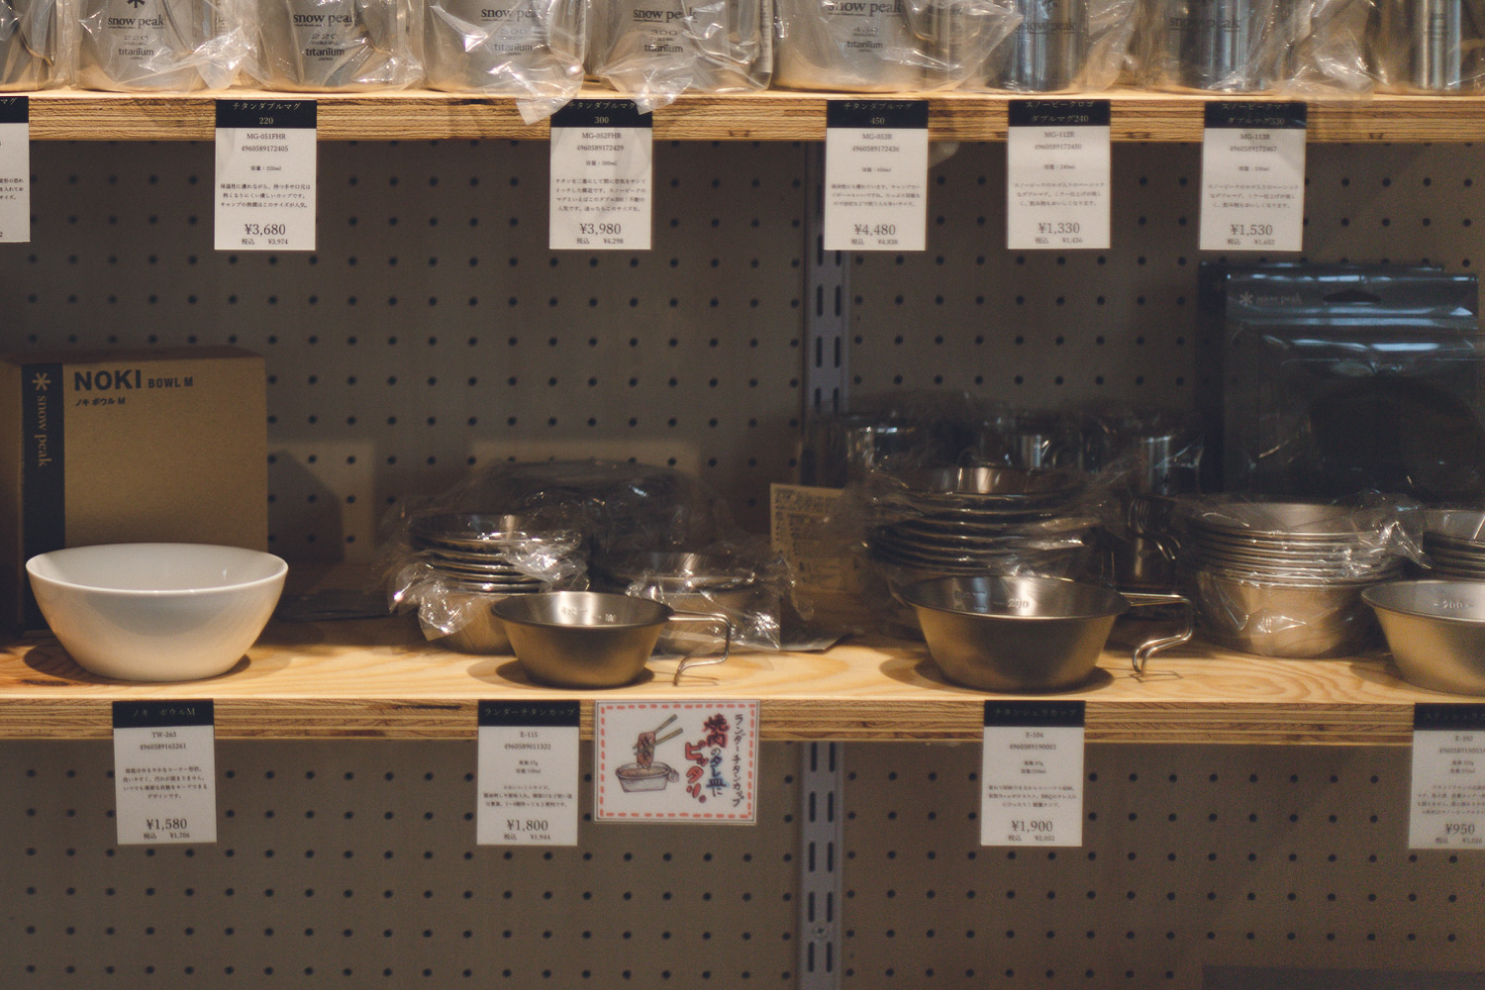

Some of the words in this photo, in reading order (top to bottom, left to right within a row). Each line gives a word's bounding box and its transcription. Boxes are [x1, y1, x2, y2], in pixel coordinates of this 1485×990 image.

[827, 1, 866, 12] snow
[293, 13, 324, 24] snow
[480, 8, 513, 19] snow
[633, 9, 664, 19] snow
[107, 17, 136, 26] snow
[137, 15, 165, 30] peak
[494, 43, 533, 52] titanium
[644, 44, 684, 54] titanium
[846, 40, 884, 49] titanium
[118, 48, 155, 57] titanium
[305, 48, 346, 57] titanium
[258, 116, 274, 125] 220
[594, 116, 610, 125] 300
[869, 116, 885, 125] 450
[245, 132, 287, 141] MG-051FHR
[580, 131, 623, 141] MG-052FHR
[861, 132, 894, 141] MG-053R
[240, 144, 290, 153] 4960589172405
[243, 222, 287, 238] ¥3,680
[578, 222, 623, 237] ¥3,980
[853, 222, 897, 238] ¥4,480
[1036, 221, 1082, 236] ¥1,330
[1229, 222, 1274, 238] ¥1,530
[73, 370, 142, 392] NOKI
[147, 377, 181, 389] BOWL
[183, 377, 194, 388] M
[37, 394, 49, 431] snow
[33, 433, 53, 468] peak
[150, 730, 178, 739] TW-263
[519, 730, 539, 739] E-115
[145, 817, 189, 832] ¥1,580
[505, 818, 550, 833] ¥1,800
[1010, 819, 1054, 834] ¥1,900
[1443, 822, 1476, 836] ¥950
